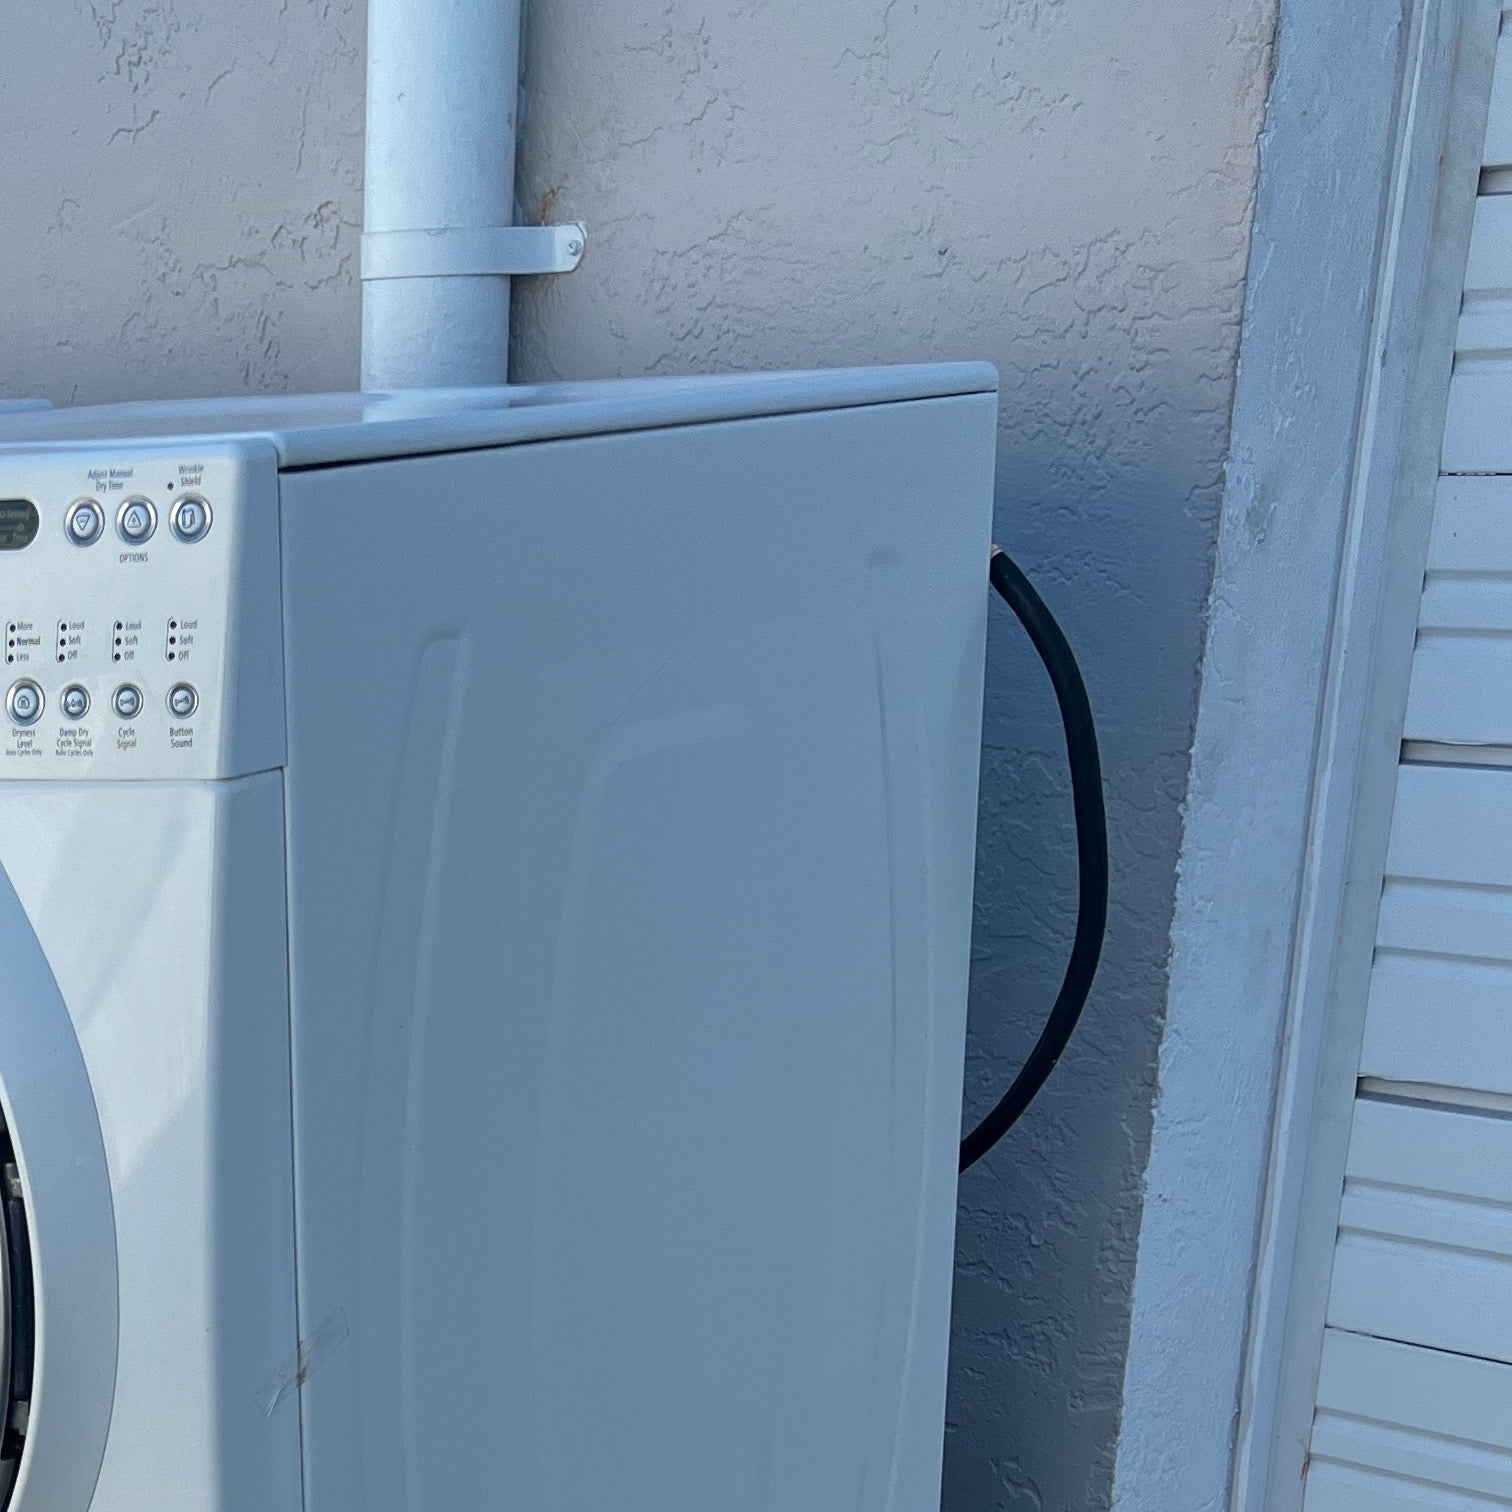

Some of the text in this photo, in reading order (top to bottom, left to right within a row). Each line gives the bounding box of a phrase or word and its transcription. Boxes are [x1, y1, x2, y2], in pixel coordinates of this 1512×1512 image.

[87, 467, 134, 481] Adjust Manual
[178, 463, 205, 475] Wrinkle
[180, 475, 202, 487] Shield
[95, 481, 124, 493] Dry Time
[119, 551, 149, 563] OPTIONS
[16, 621, 33, 631] More
[68, 620, 85, 630] Loud
[125, 620, 142, 630] Loud
[180, 618, 198, 629] Loud
[16, 636, 41, 646] Normal
[68, 634, 82, 645] Soft
[125, 635, 138, 645] Soft
[179, 634, 194, 645] Soft
[67, 649, 78, 660] Off
[123, 650, 135, 660] Off
[178, 650, 189, 660] Off
[12, 728, 36, 738] Dryness
[59, 728, 90, 738] Damp Dry
[118, 727, 136, 738] Cycle
[169, 727, 194, 737] Button
[17, 740, 33, 749] Level
[56, 738, 93, 749] Cycle Signal
[117, 738, 137, 751] Signal
[170, 738, 193, 748] Sound
